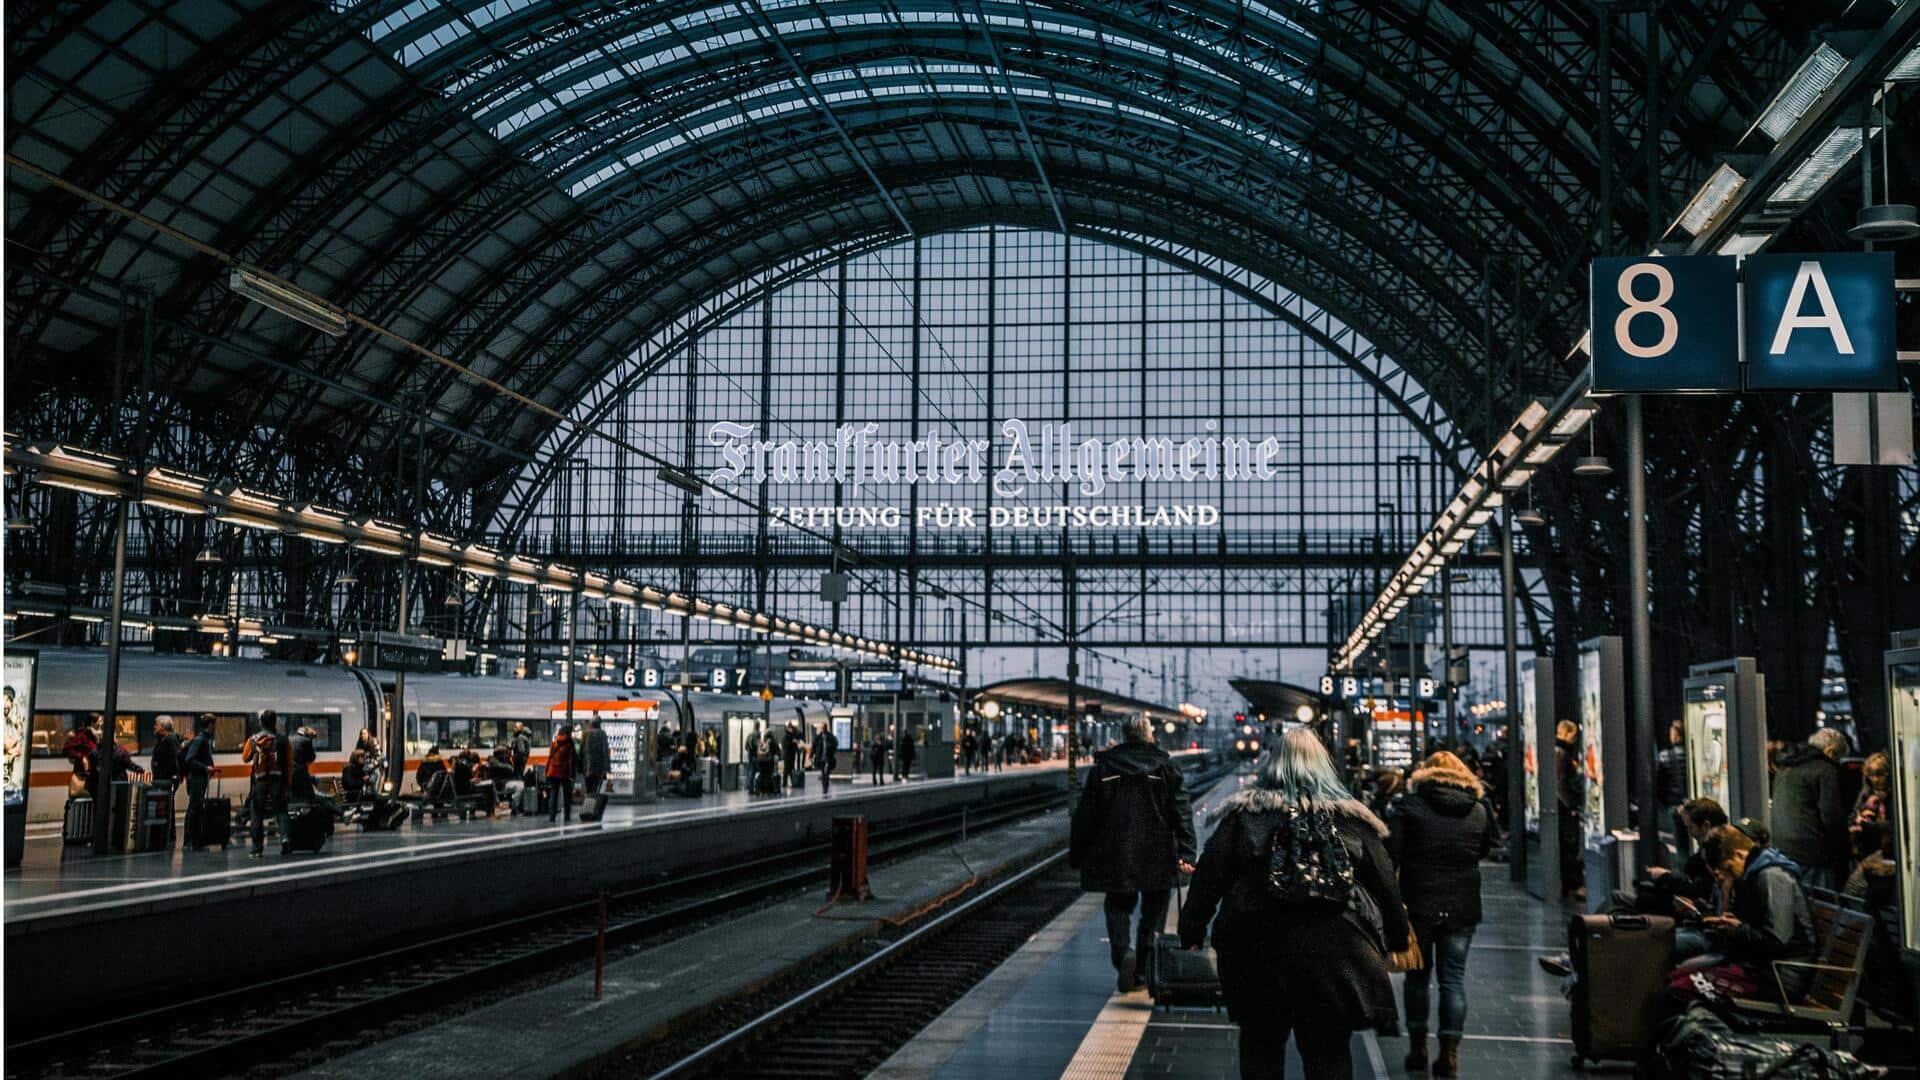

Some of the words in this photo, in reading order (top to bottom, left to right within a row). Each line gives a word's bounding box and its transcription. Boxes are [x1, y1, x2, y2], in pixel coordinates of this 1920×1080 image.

[1614, 263, 1678, 358] 8
[1769, 261, 1855, 354] A
[708, 421, 990, 497] Frankfurter
[993, 418, 1280, 497] Allgemeine
[769, 506, 901, 527] ZEITUNG
[916, 502, 976, 527] FÜR
[989, 505, 1219, 528] DEUTSCHLAND
[624, 668, 635, 687] 6
[644, 668, 658, 687] B
[713, 668, 726, 687] B
[735, 668, 746, 687] 7
[1321, 676, 1334, 695] 8
[1343, 677, 1357, 696] B
[1420, 678, 1434, 697] B
